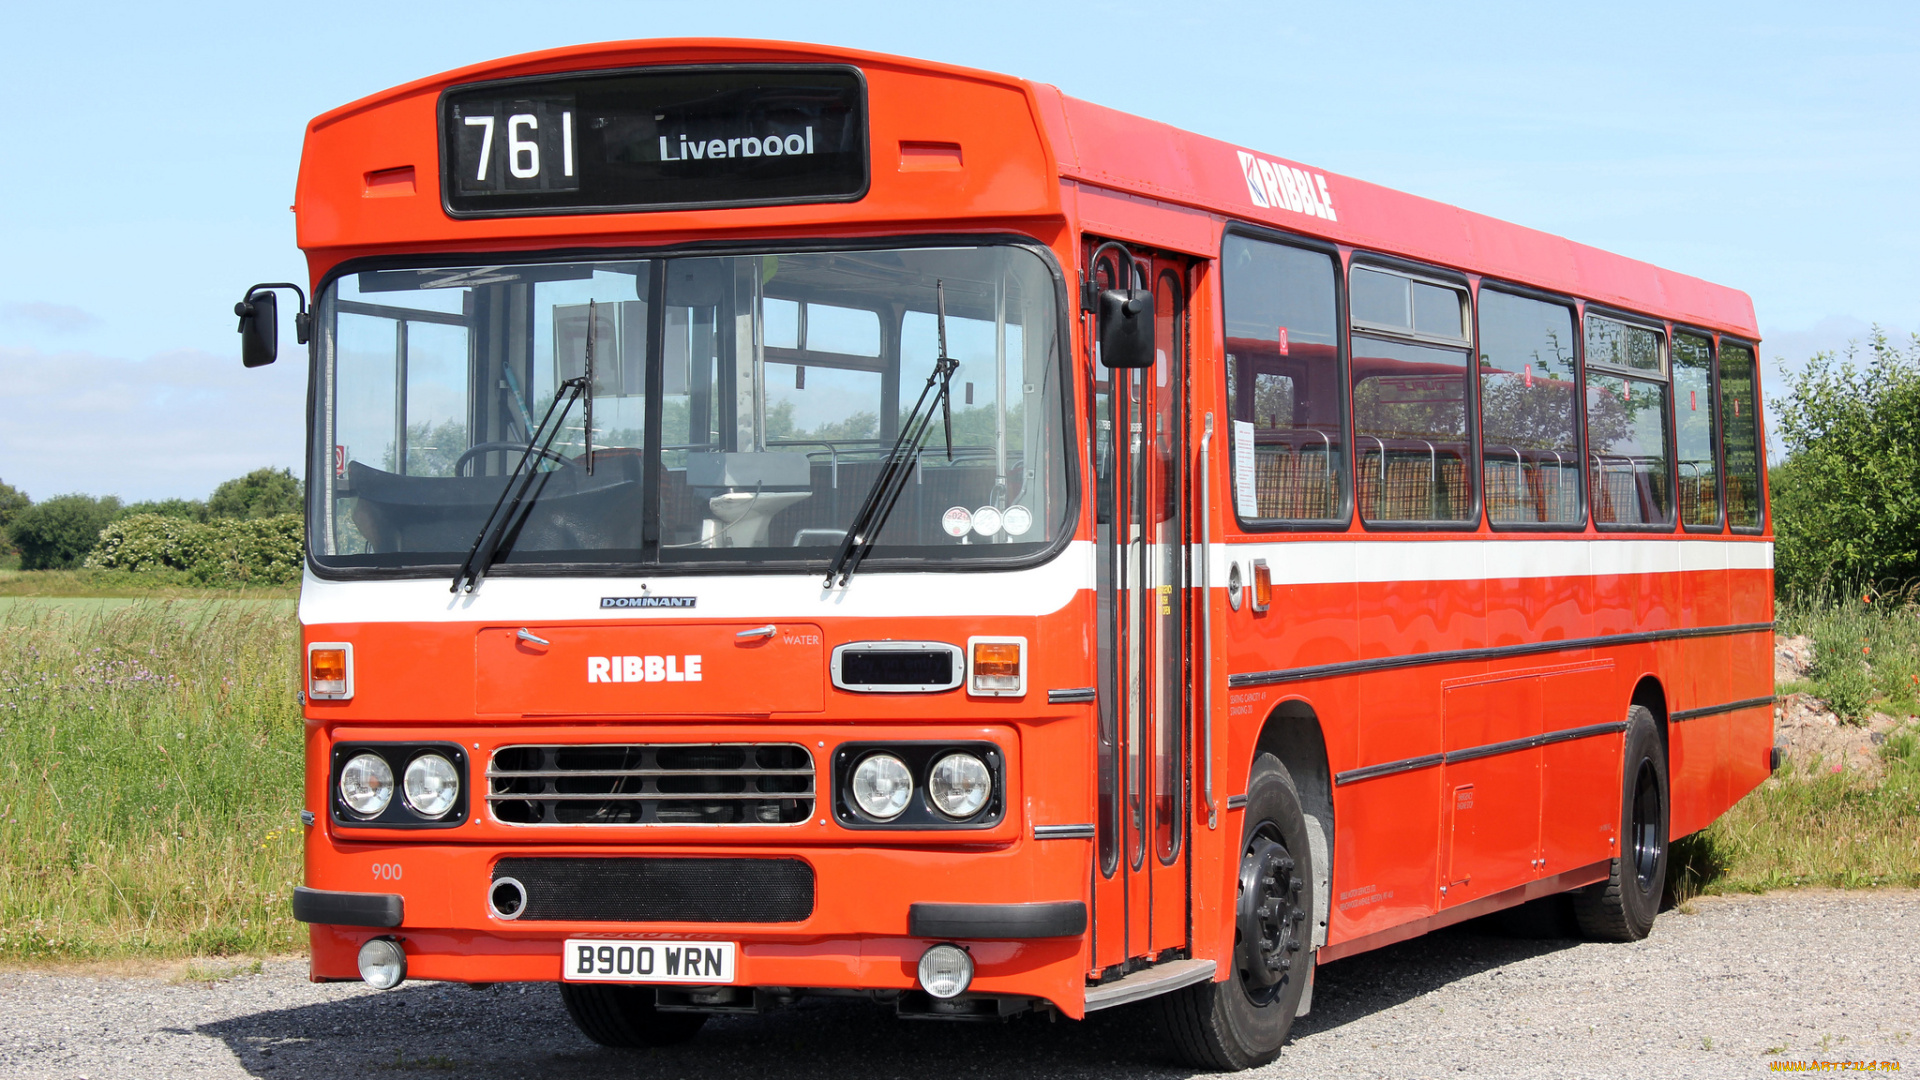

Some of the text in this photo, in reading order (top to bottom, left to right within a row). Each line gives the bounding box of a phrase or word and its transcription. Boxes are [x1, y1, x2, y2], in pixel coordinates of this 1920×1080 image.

[464, 112, 574, 181] 761
[659, 126, 814, 161] Liverpool
[1257, 157, 1338, 222] RIBBLE
[602, 598, 695, 607] DOMINANT
[783, 635, 819, 645] WATER
[588, 655, 702, 683] RIBBLE
[372, 863, 402, 880] 900
[577, 945, 722, 976] B900 WRN
